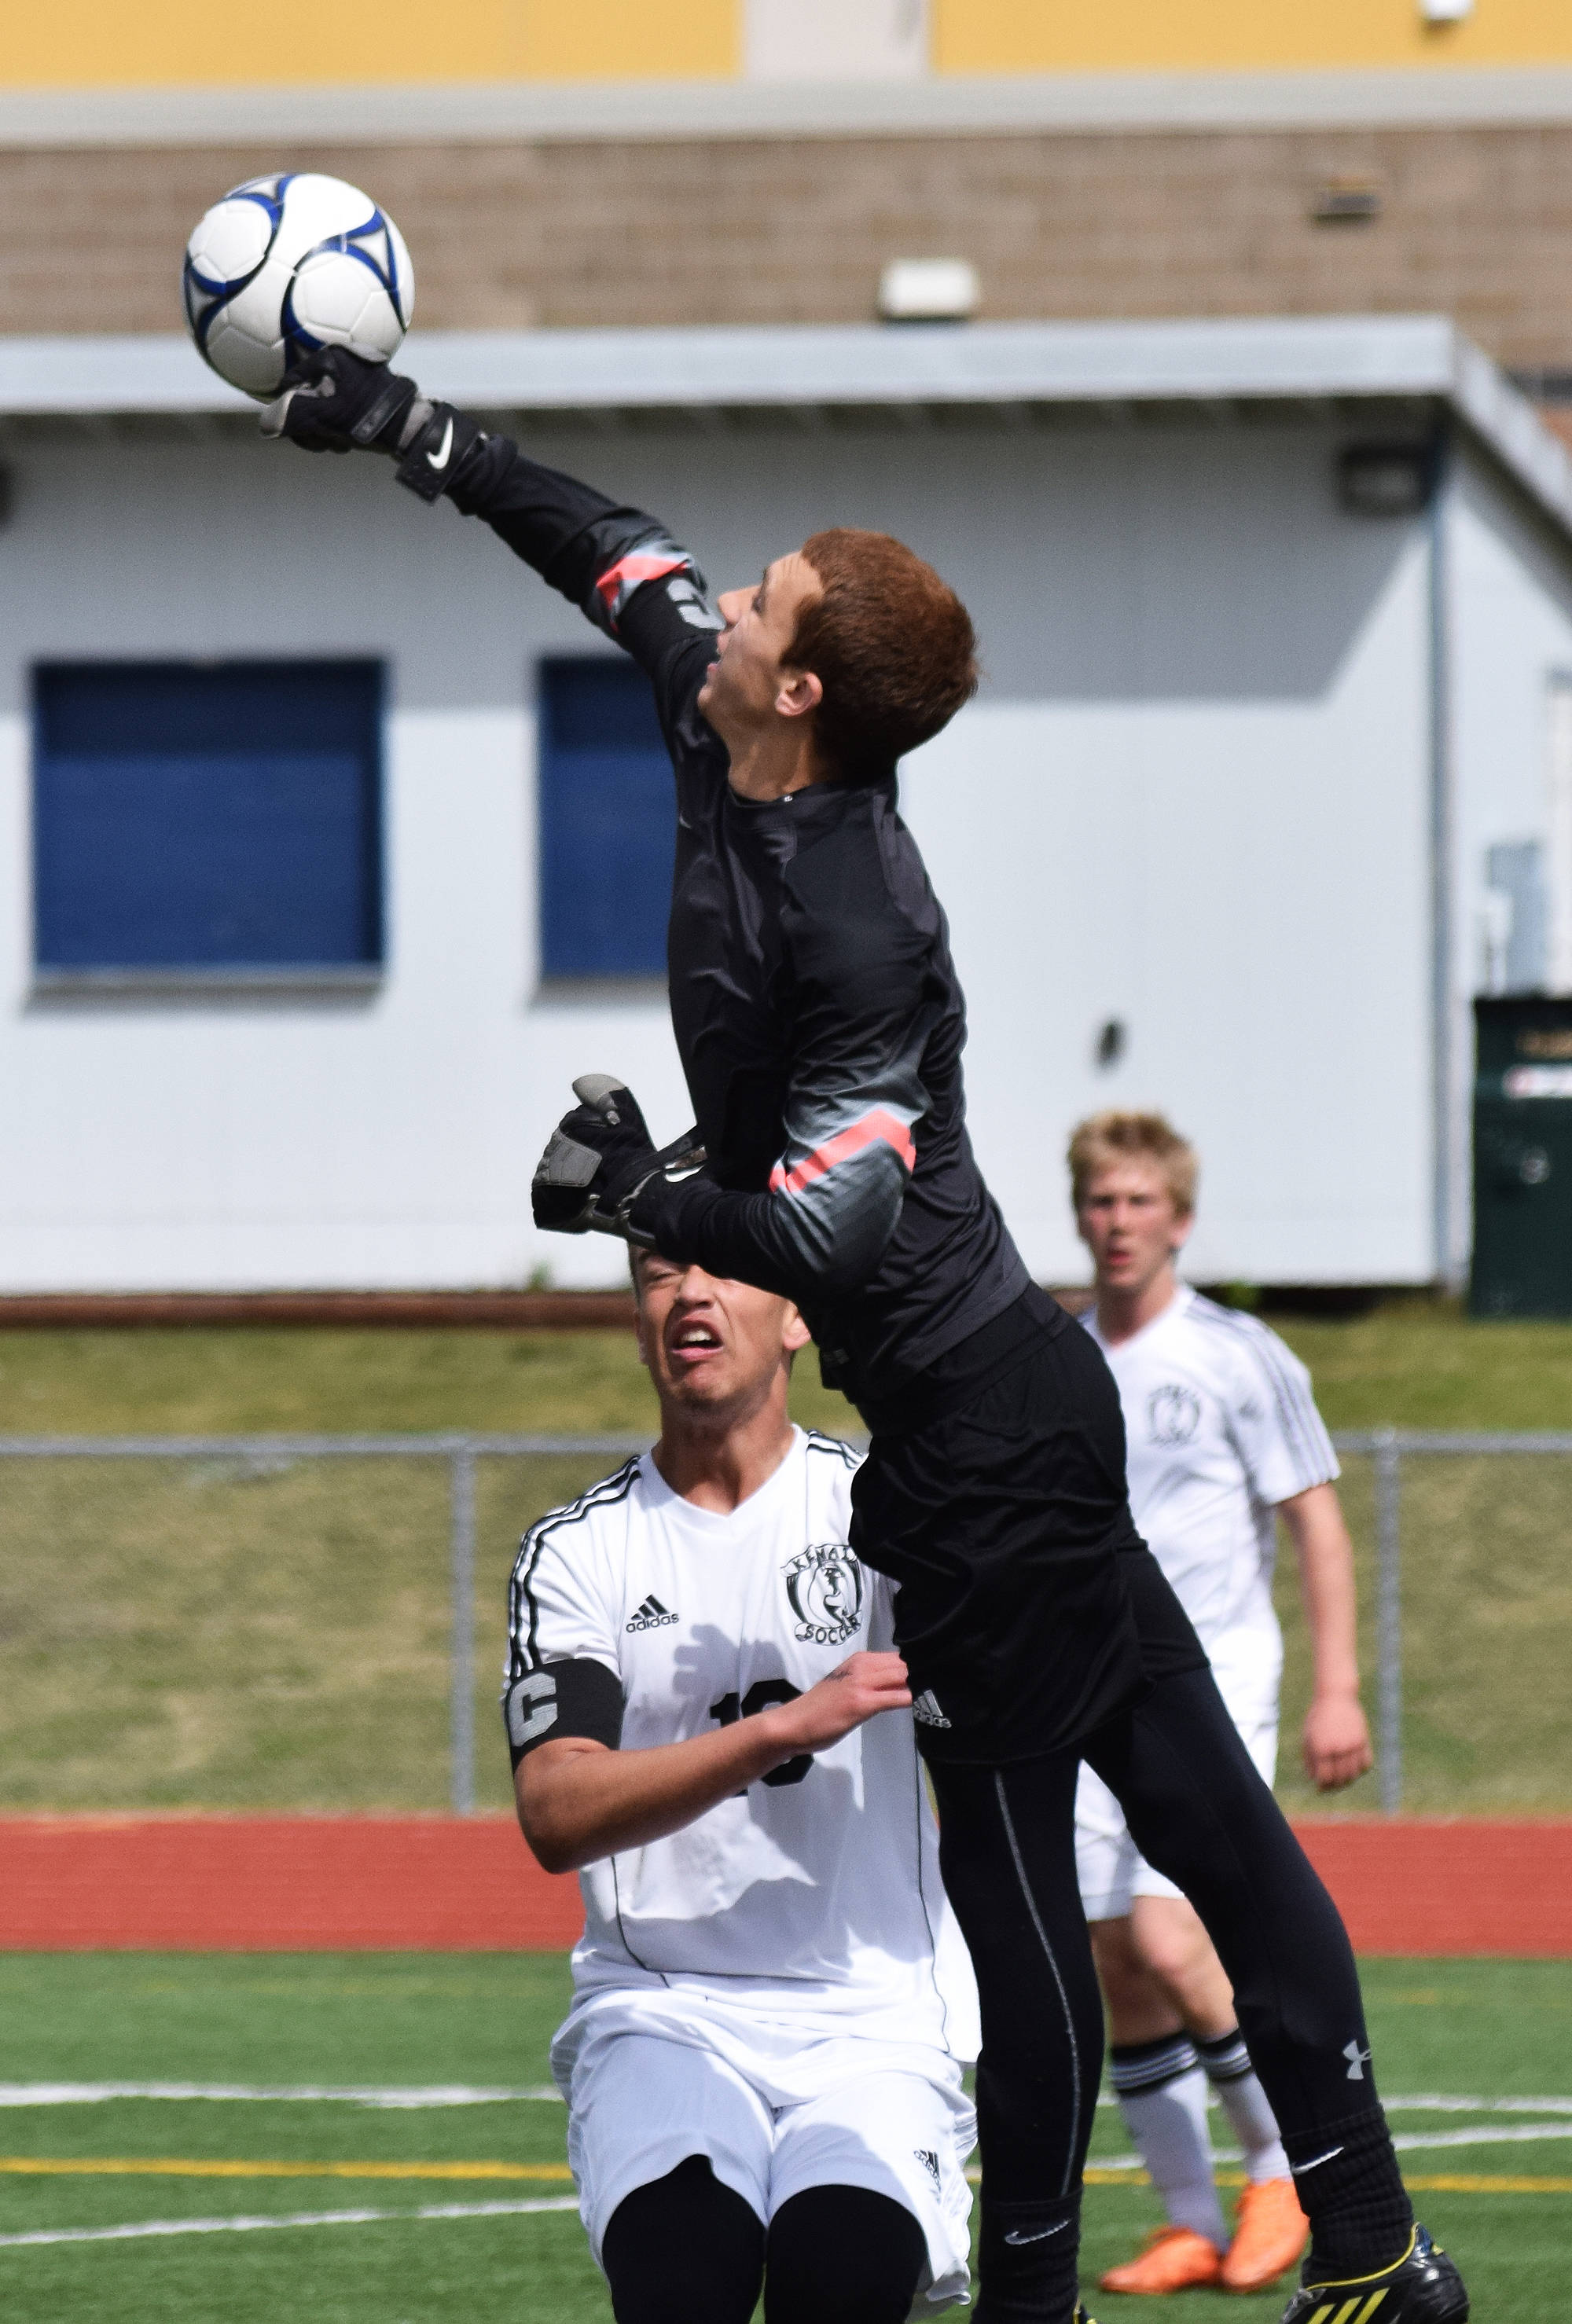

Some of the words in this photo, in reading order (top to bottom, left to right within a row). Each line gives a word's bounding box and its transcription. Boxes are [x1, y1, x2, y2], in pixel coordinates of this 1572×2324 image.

[793, 1547, 851, 1570] KENAI
[626, 1613, 679, 1633] adidas
[805, 1617, 861, 1644] SOCCER
[508, 1672, 558, 1747] C
